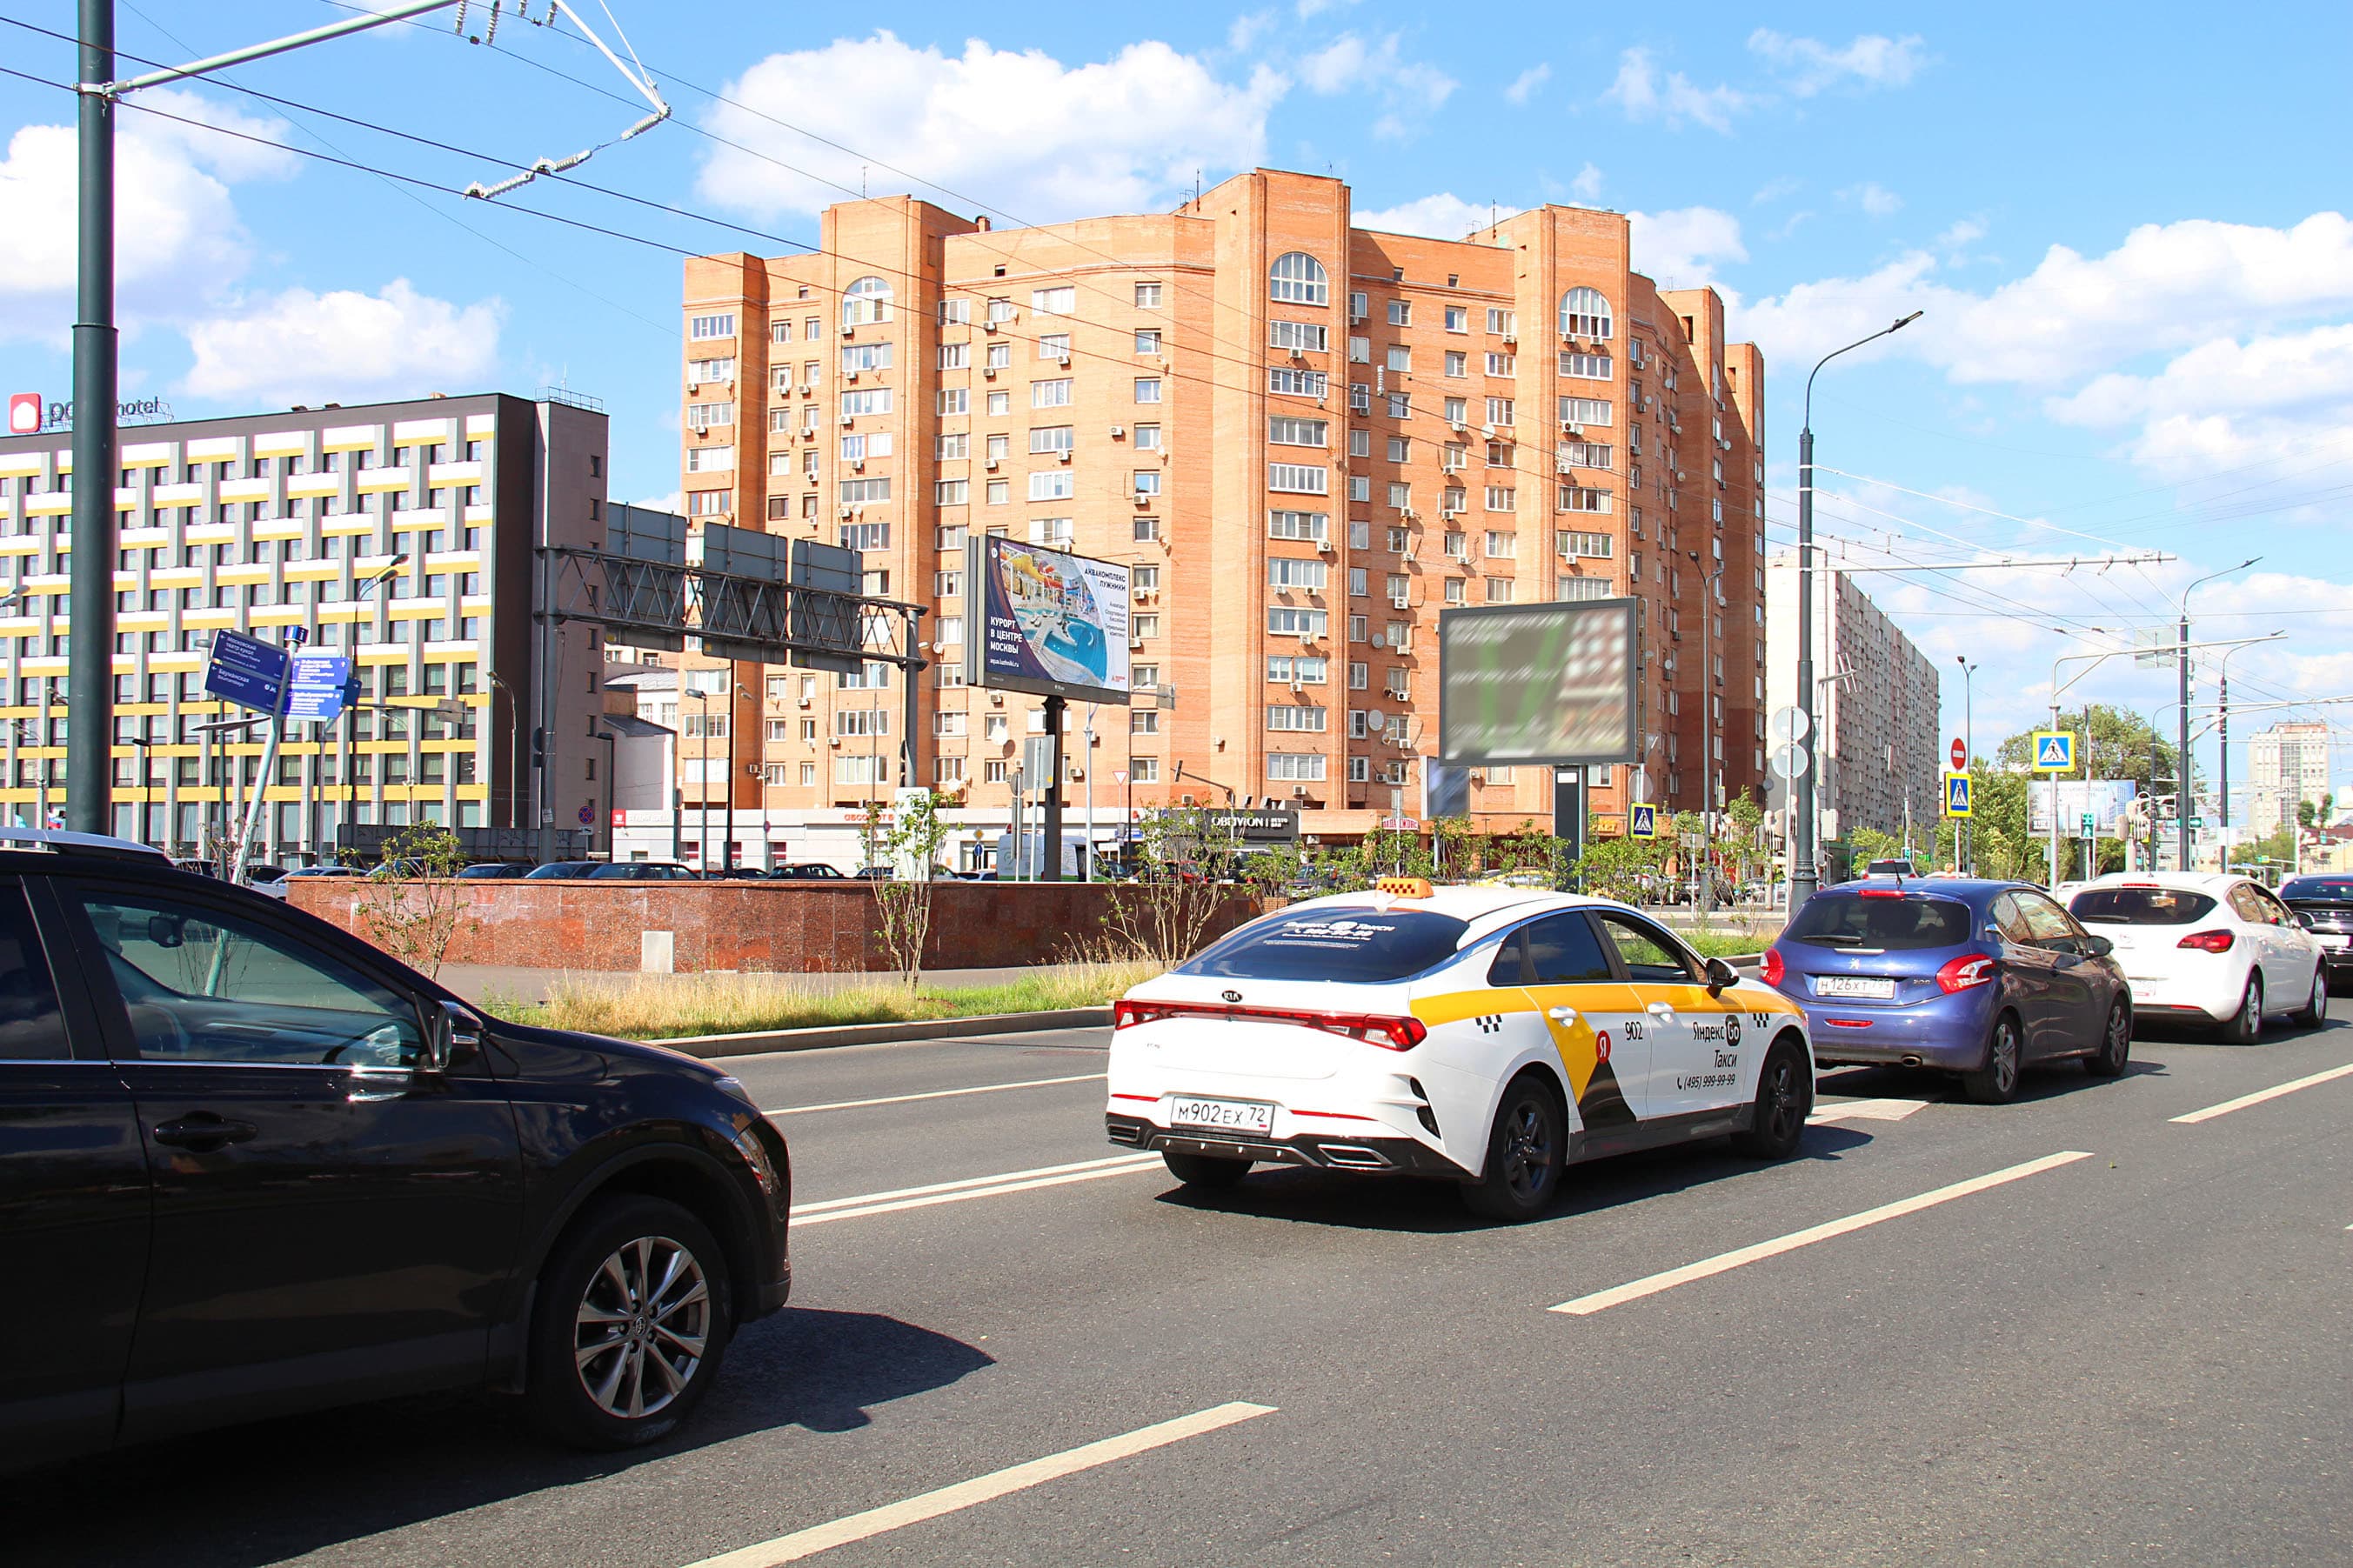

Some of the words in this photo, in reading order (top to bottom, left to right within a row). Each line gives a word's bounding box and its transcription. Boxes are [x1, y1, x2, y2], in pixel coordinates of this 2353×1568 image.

[1084, 567, 1126, 584] АКВАКОМПЛЕКС
[1099, 580, 1126, 592] ЛУЖНИКИ
[990, 616, 1016, 630] КУРОРТ
[990, 629, 996, 638] В
[997, 630, 1023, 644] ЦЕНТРЕ
[990, 641, 1019, 655] МОСКВЫ
[1211, 817, 1264, 828] OBLVION
[1223, 991, 1240, 1002] KIA
[1625, 1021, 1643, 1041] 902
[1693, 1021, 1725, 1044] Яндекс
[1728, 1022, 1741, 1041] Go
[1599, 1036, 1608, 1058] Я
[1714, 1050, 1738, 1069] Такси
[1683, 1076, 1702, 1091] (495)
[1702, 1073, 1735, 1088] 999-99-99
[1177, 1103, 1244, 1124] М902ЕХ
[1249, 1107, 1266, 1122] 72
